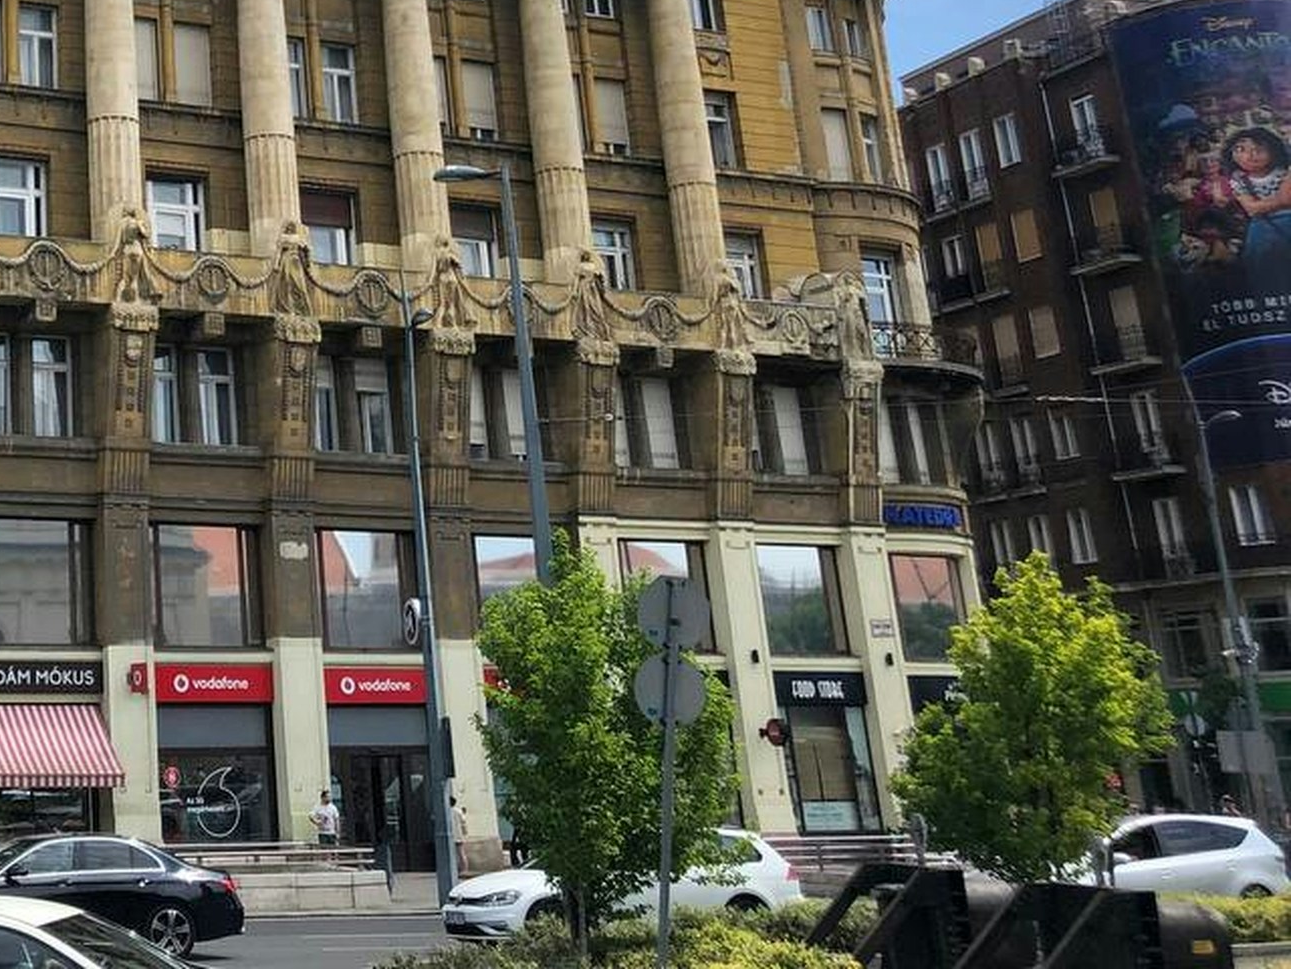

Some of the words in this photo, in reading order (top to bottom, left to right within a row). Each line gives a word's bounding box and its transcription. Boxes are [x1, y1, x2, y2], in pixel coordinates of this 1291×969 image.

[35, 666, 95, 686] MÓKUS
[192, 675, 250, 690] vodafone
[357, 678, 411, 692] vodafone
